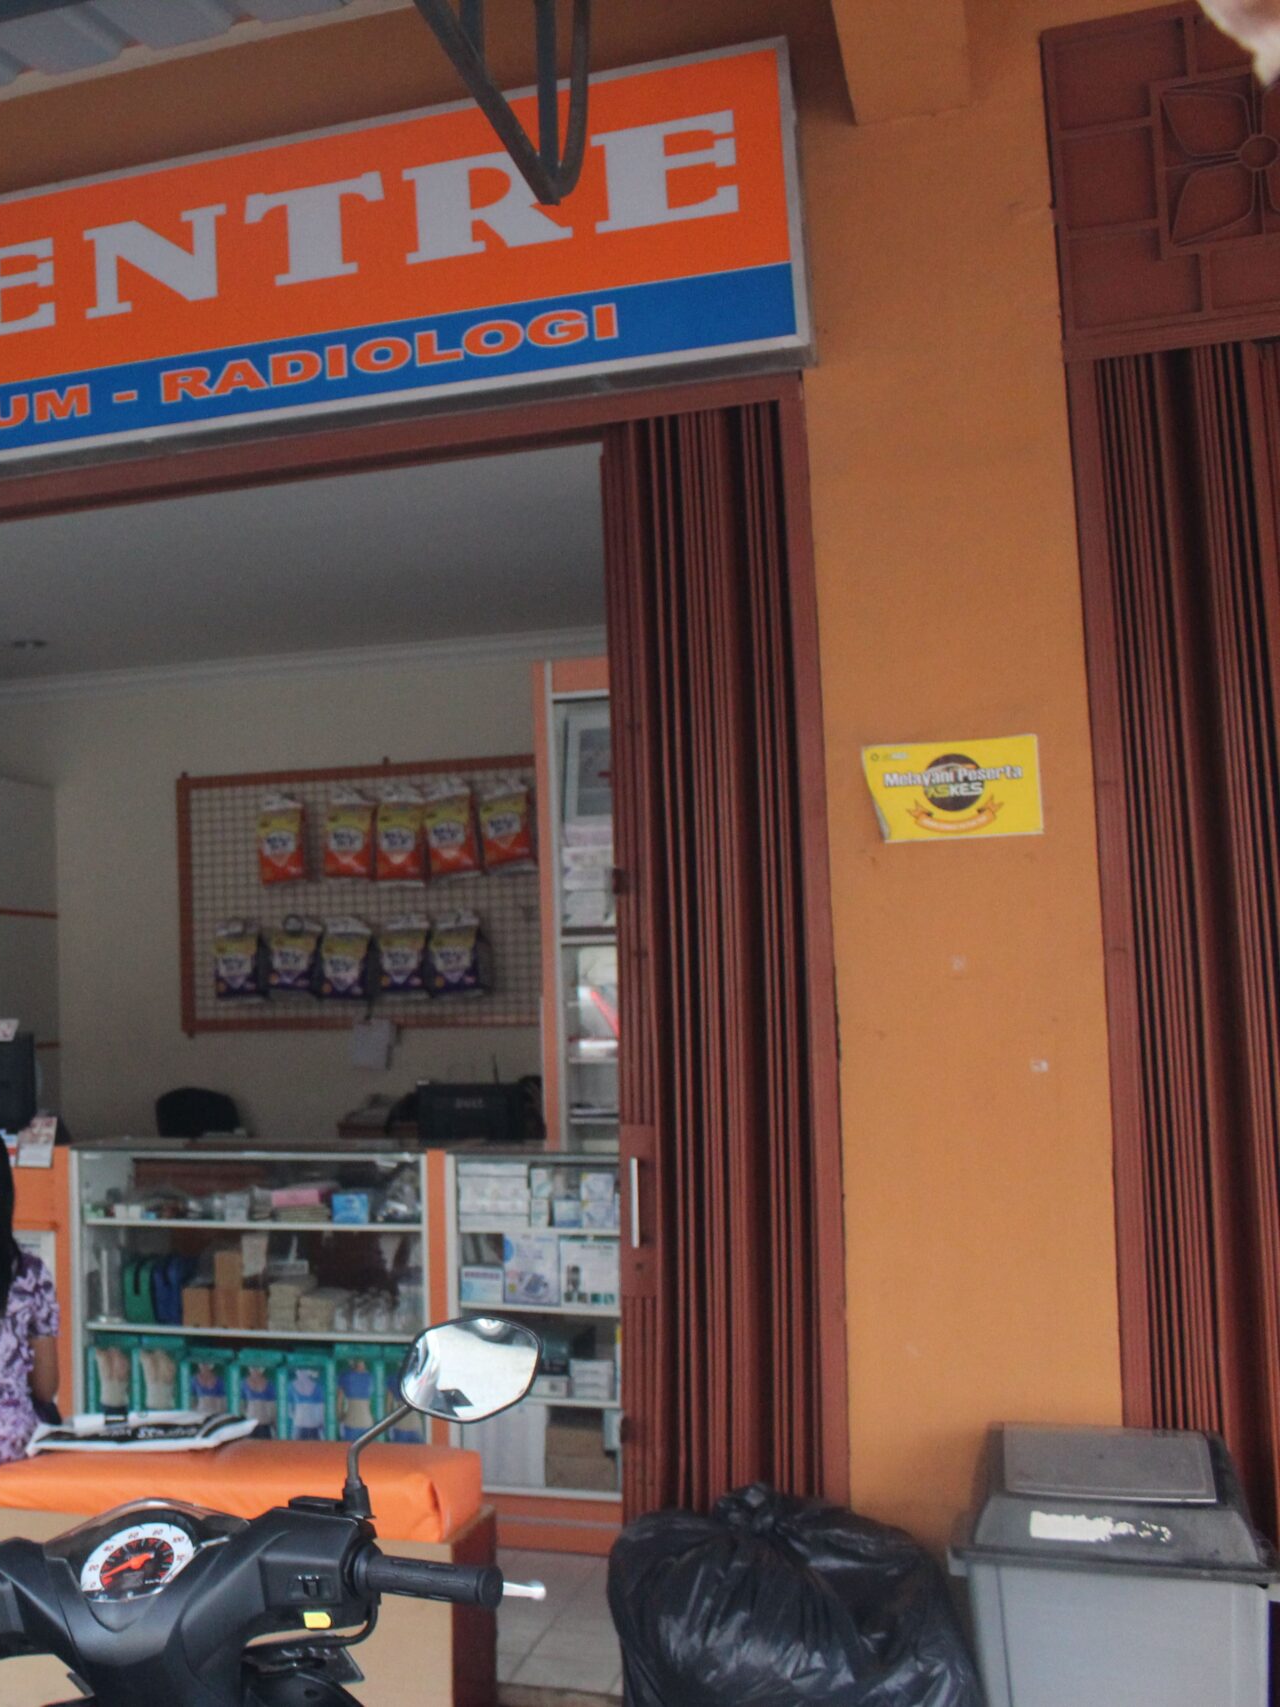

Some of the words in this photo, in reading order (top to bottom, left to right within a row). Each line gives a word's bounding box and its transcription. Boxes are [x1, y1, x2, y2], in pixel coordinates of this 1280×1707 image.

[160, 302, 619, 403] RADIOLOGI
[883, 769, 955, 788] Melayani
[957, 764, 1024, 782] Peserta
